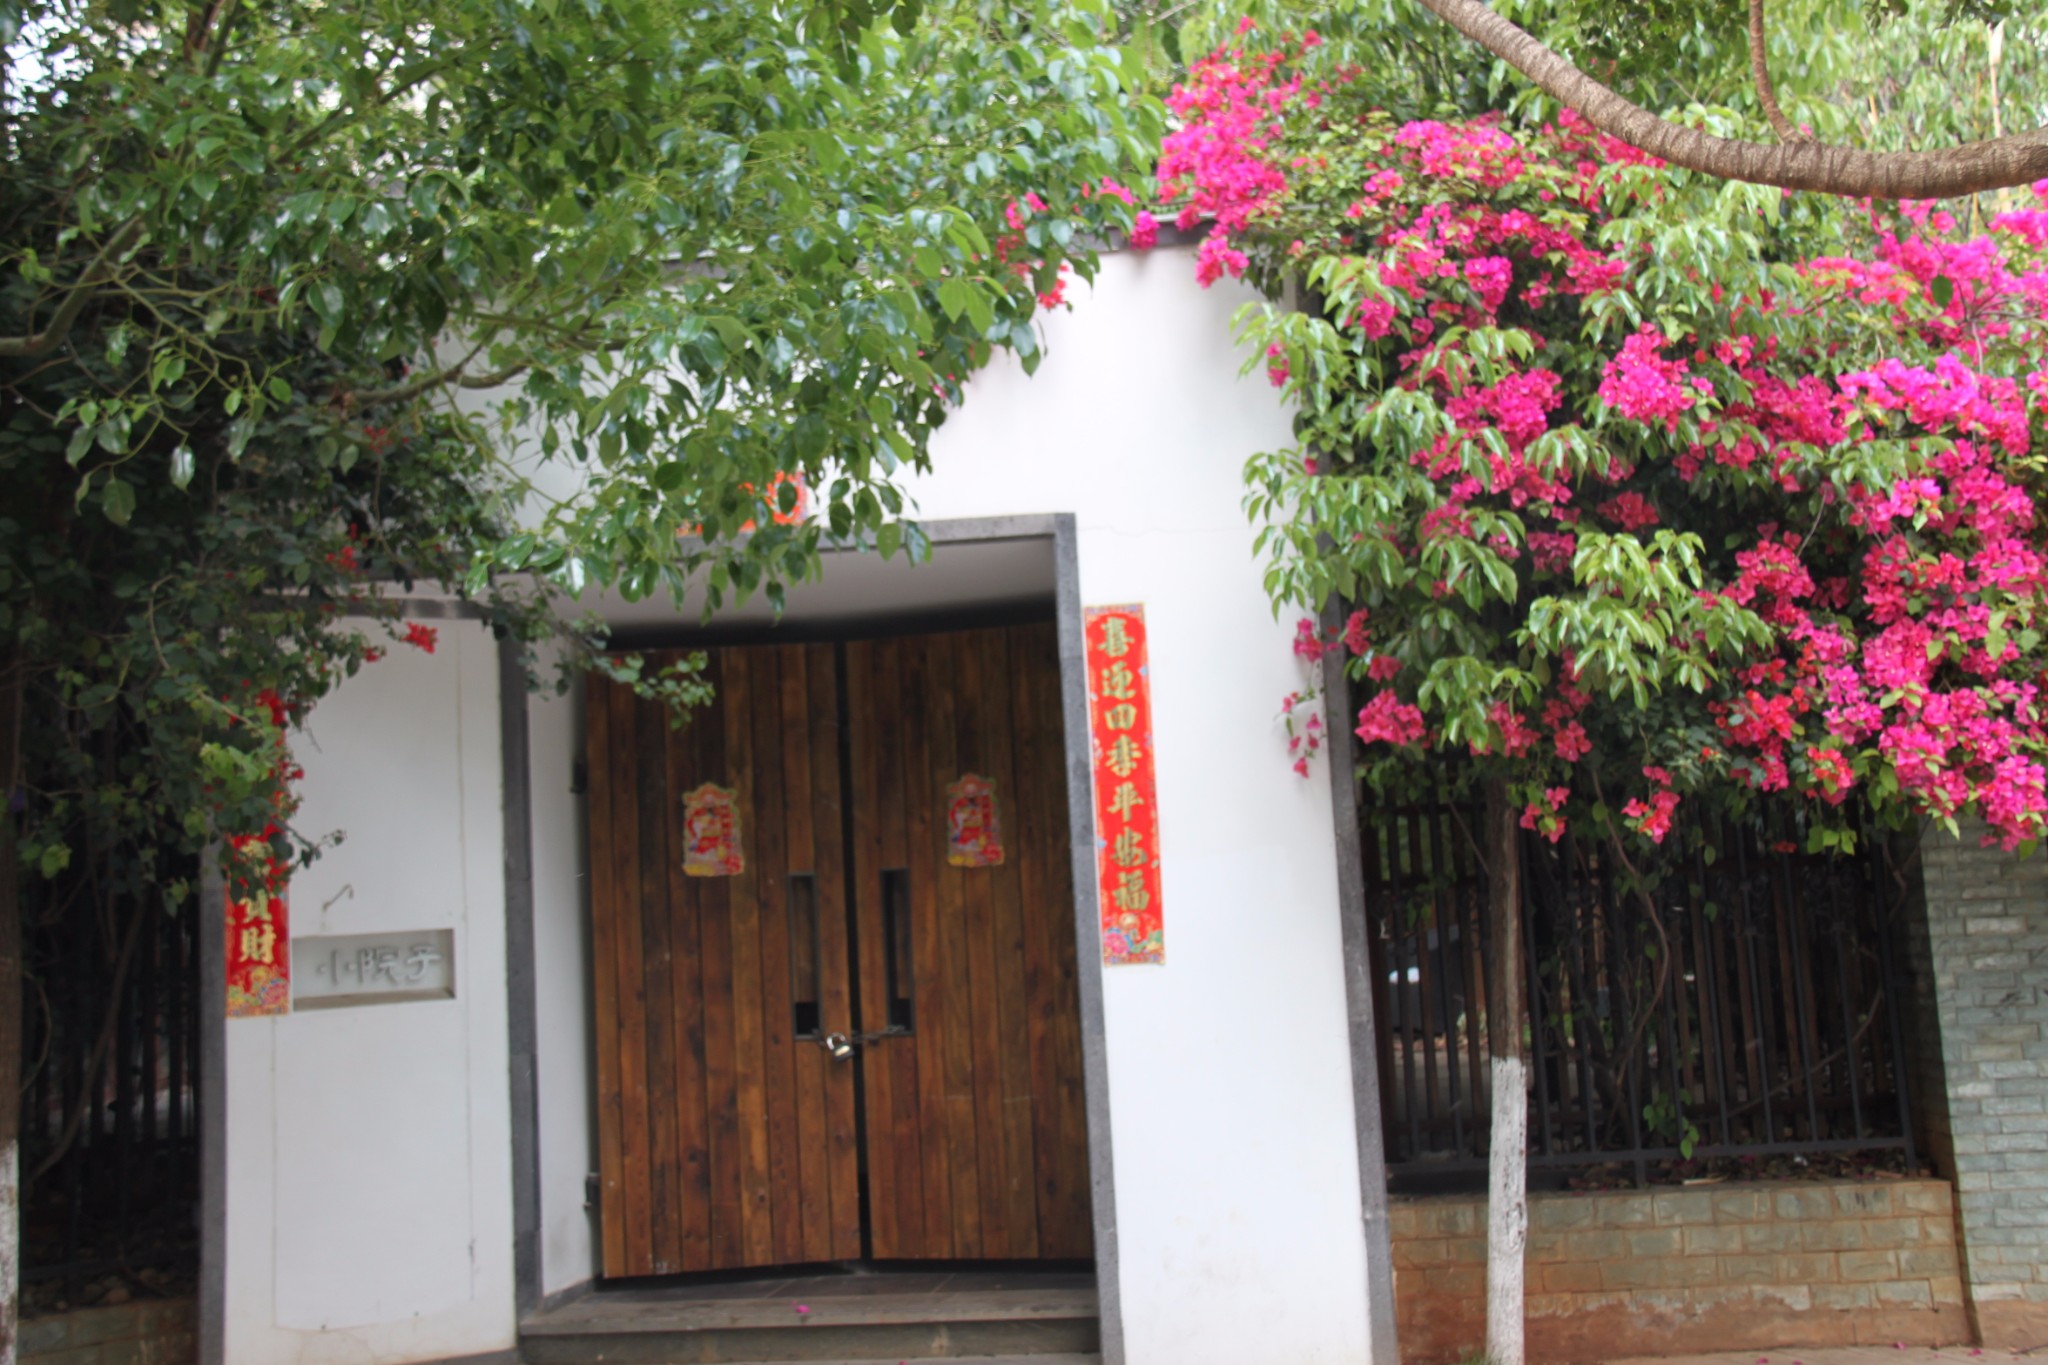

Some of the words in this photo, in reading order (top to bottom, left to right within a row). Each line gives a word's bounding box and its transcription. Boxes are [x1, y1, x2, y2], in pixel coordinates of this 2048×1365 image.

[1098, 617, 1150, 912] 喜迎四季平安福
[316, 943, 442, 985] 小院子
